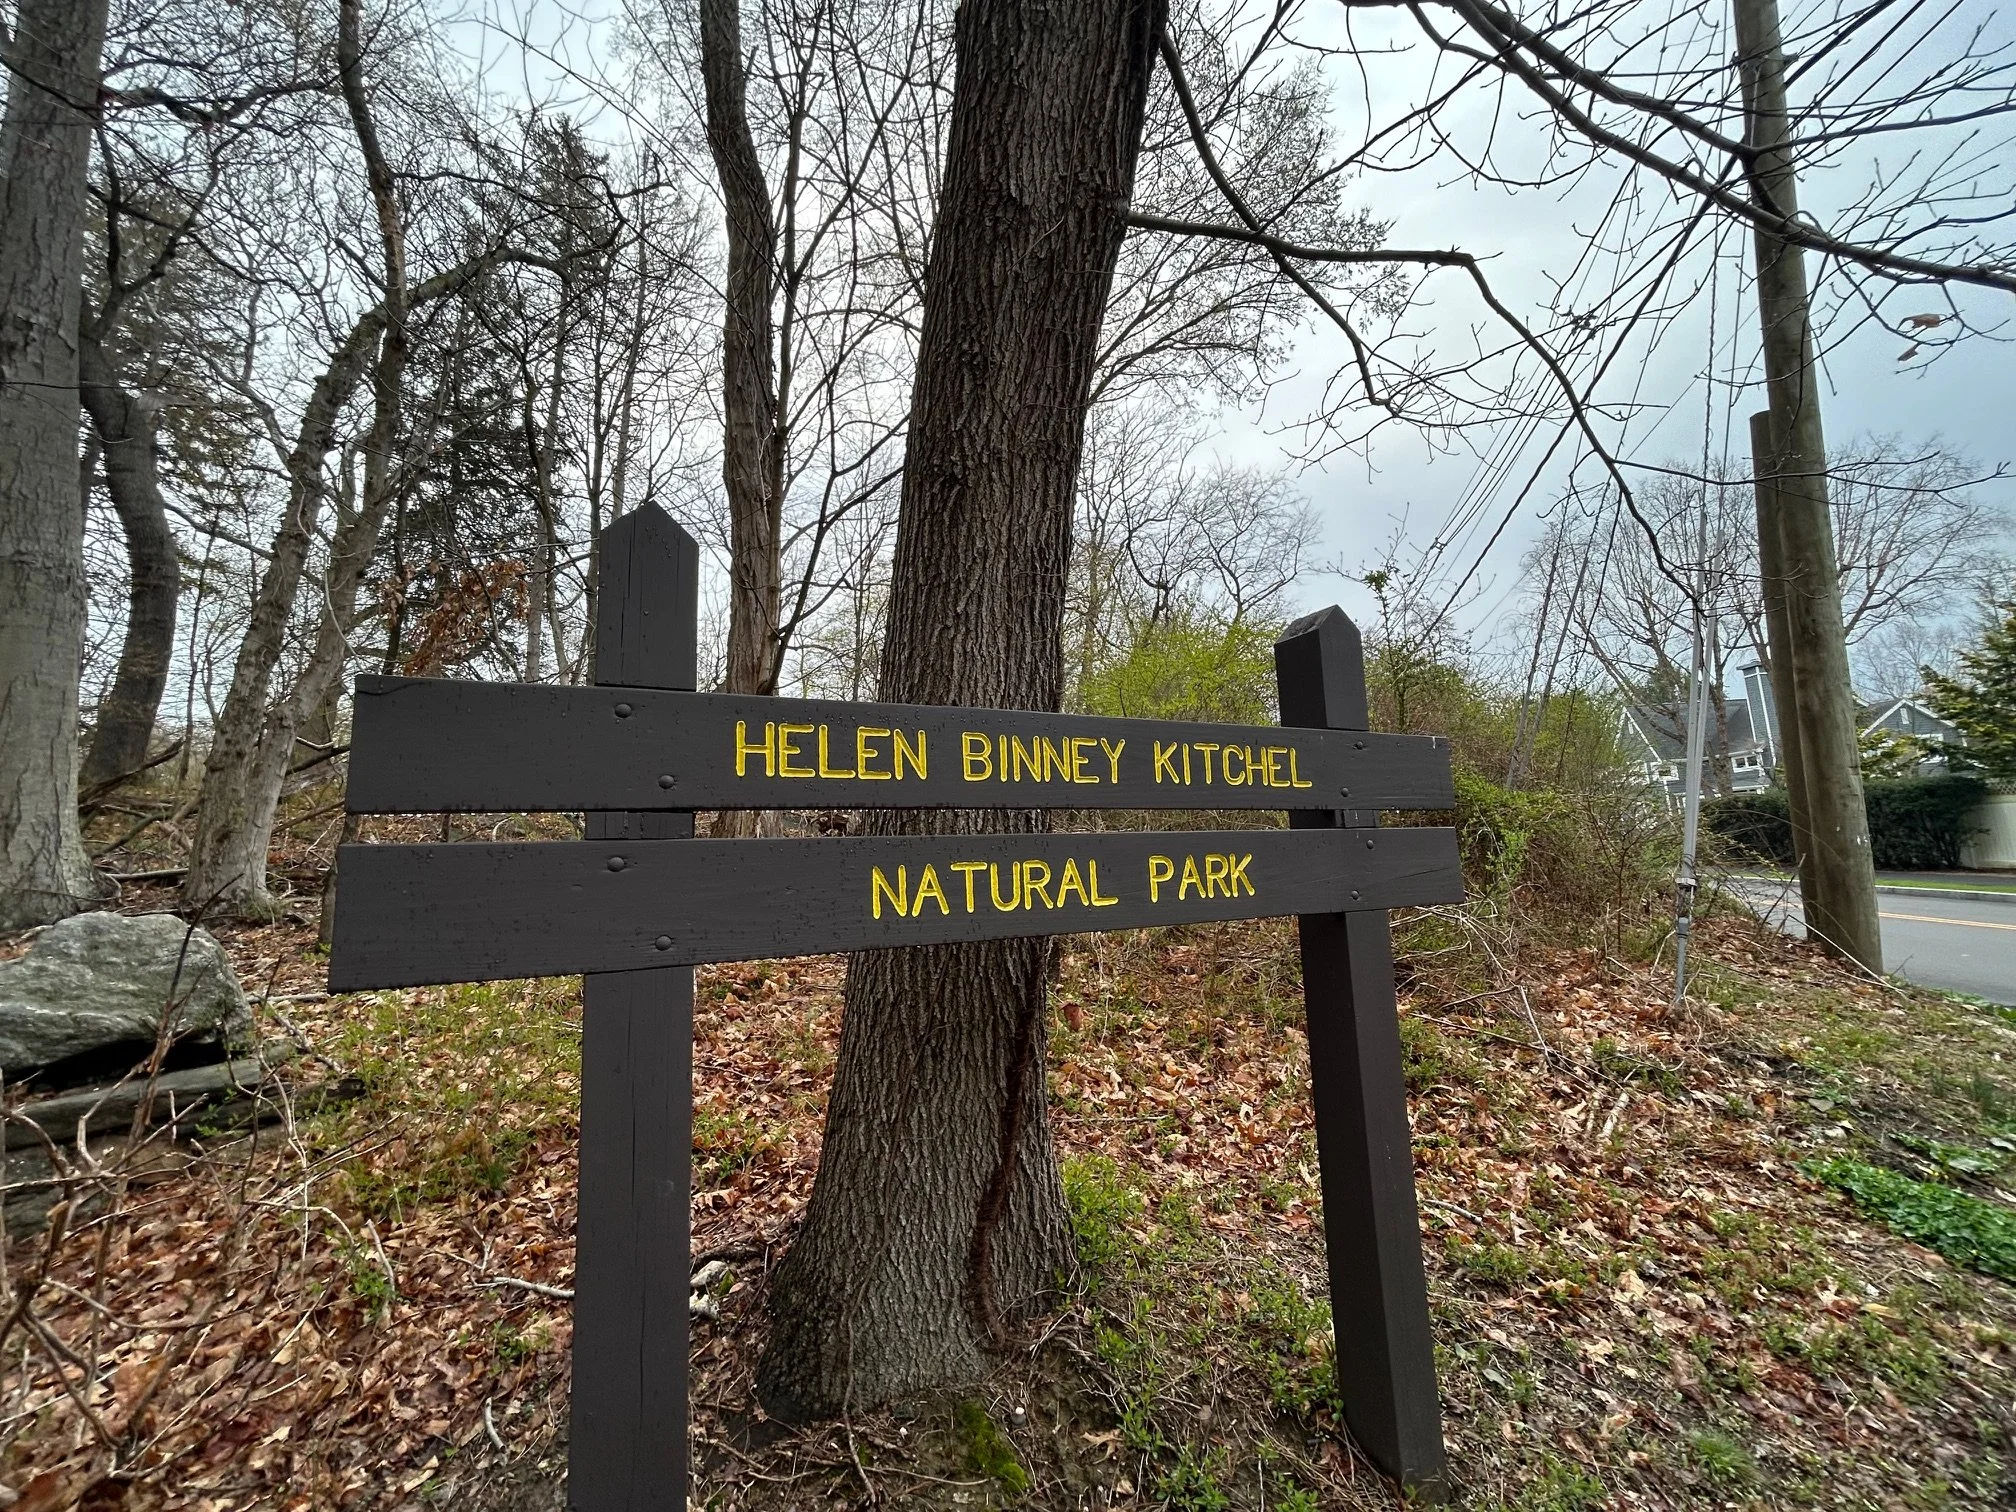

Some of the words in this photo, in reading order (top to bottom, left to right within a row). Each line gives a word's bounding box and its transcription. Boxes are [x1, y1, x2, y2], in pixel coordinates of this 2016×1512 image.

[735, 720, 927, 781] HELEN
[962, 730, 1126, 784] BINNEY
[1153, 740, 1313, 788] KITCHEL
[871, 857, 1119, 919] NATURAL
[1148, 852, 1256, 902] PARK
